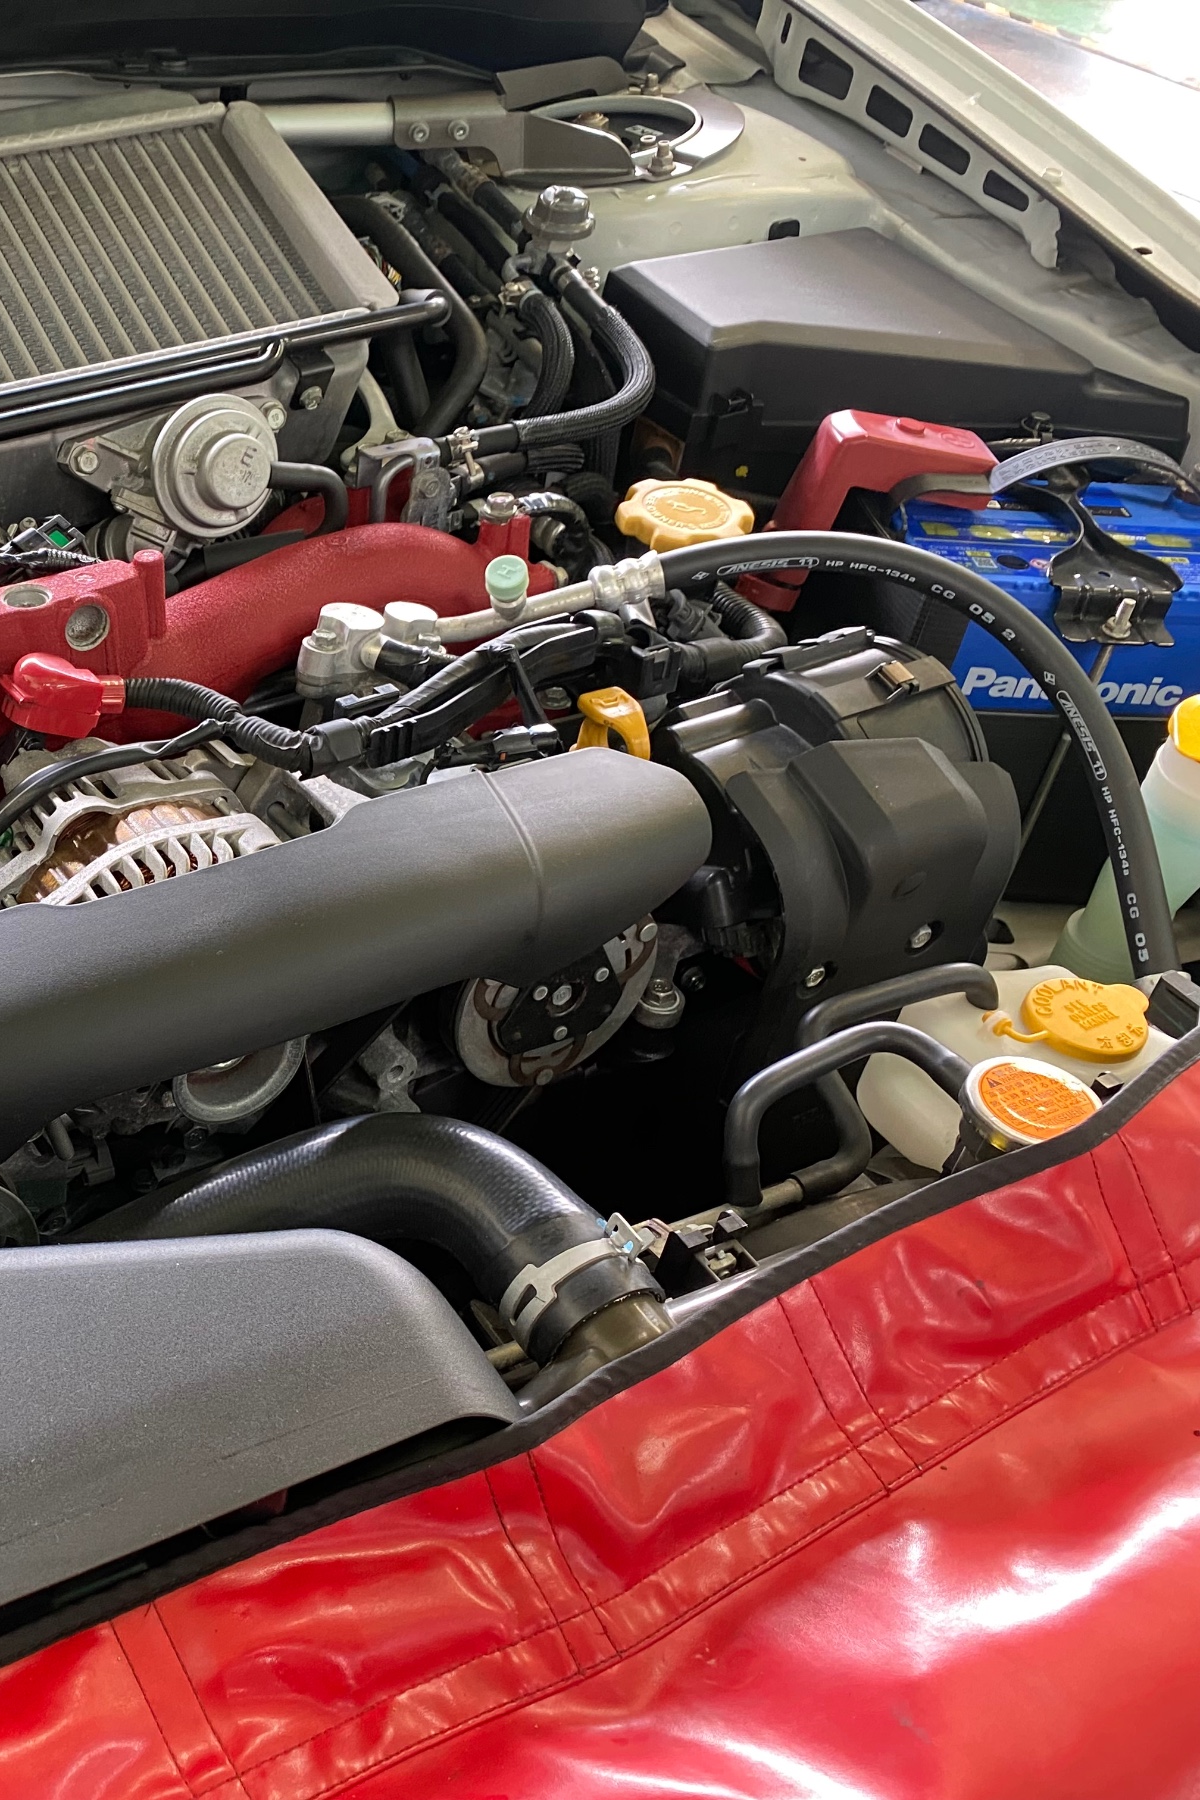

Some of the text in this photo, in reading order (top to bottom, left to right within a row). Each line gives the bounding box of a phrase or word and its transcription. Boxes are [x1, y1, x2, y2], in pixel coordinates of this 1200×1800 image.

[826, 559, 844, 568] HP
[850, 562, 917, 583] HFC-134a
[931, 584, 955, 600] CG
[1001, 628, 1016, 641] 2
[961, 666, 1184, 707] Panonic
[1101, 786, 1113, 804] HP
[1108, 809, 1130, 876] HFC-134a
[1127, 892, 1140, 919] CG
[1032, 979, 1104, 1017] COOLANT
[1078, 1011, 1120, 1032] MANUAL
